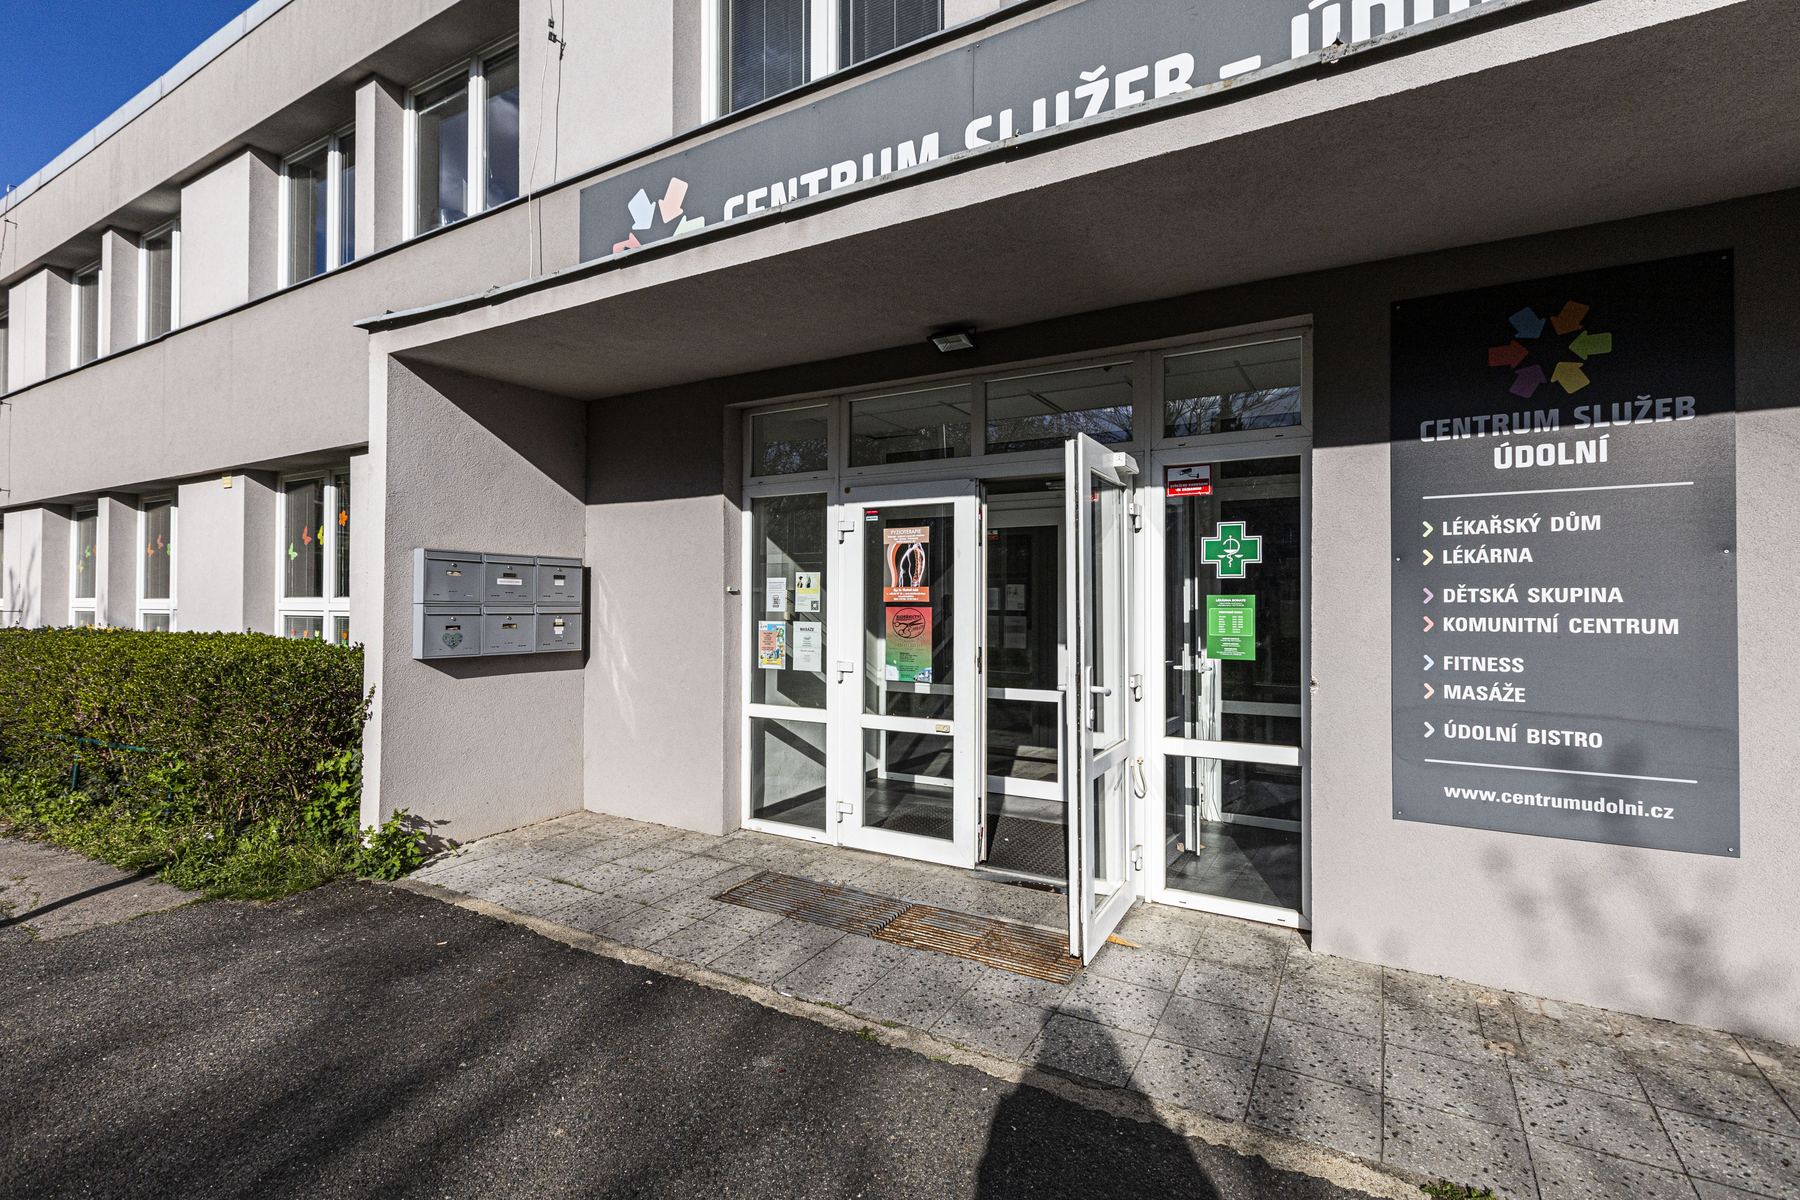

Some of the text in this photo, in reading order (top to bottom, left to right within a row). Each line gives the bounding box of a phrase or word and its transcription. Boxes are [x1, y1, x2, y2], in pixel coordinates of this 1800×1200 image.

[1419, 395, 1696, 442] CENTRUM SLUŽEB
[1494, 433, 1609, 469] ÚDOLNÍ
[1442, 511, 1601, 536] LÉKAŘSKÝ DŮM
[1442, 544, 1533, 565] LÉKÁRNA
[1443, 584, 1624, 604] DĚTSKÁ SKUPINA
[1443, 613, 1679, 635] KOMUNITNÍ CENTRUM
[1443, 655, 1525, 673] FITNESS
[1443, 682, 1526, 703] MASÁŽE
[1444, 720, 1603, 748] ÚDOLNÍ BISTRO
[1444, 786, 1675, 820] www.centrumudolni.cz
